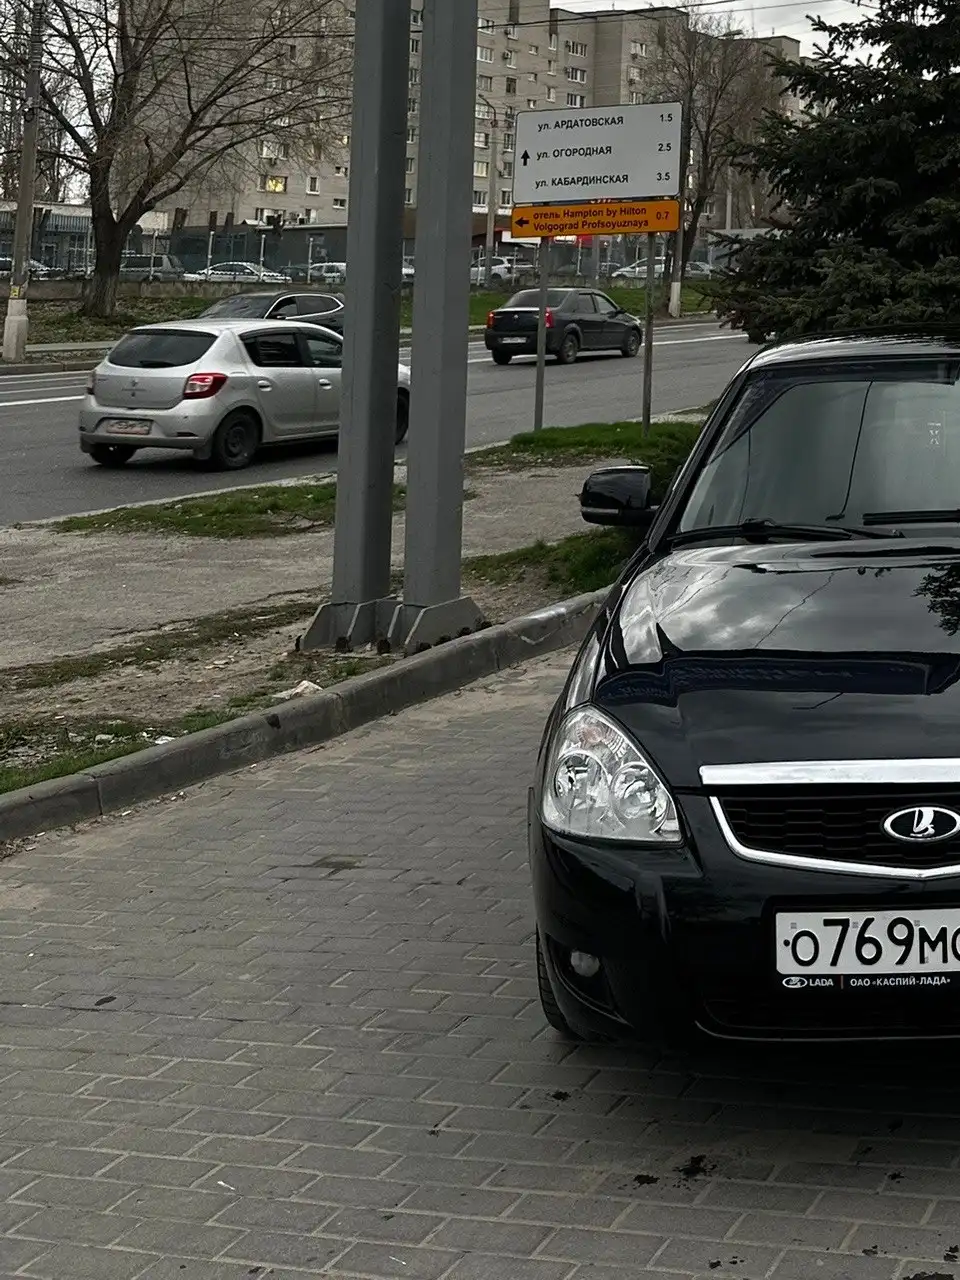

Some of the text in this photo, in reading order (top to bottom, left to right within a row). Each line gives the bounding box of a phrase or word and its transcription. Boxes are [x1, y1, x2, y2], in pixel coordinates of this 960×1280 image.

[537, 113, 673, 133] ул. АРДАТОВСКАЯ 1.5
[536, 142, 672, 161] ул. ОГОРОДНАЯ 2.5
[535, 171, 671, 190] ул. КАБАРДИНСКАЯ 3.5
[533, 206, 670, 221] отель Hampton by Hilton 0.7
[533, 219, 649, 232] Volgograd Profsoyuznaya
[809, 974, 951, 988] LADA ОАО «КАСПИЙ-ЛАДА»
